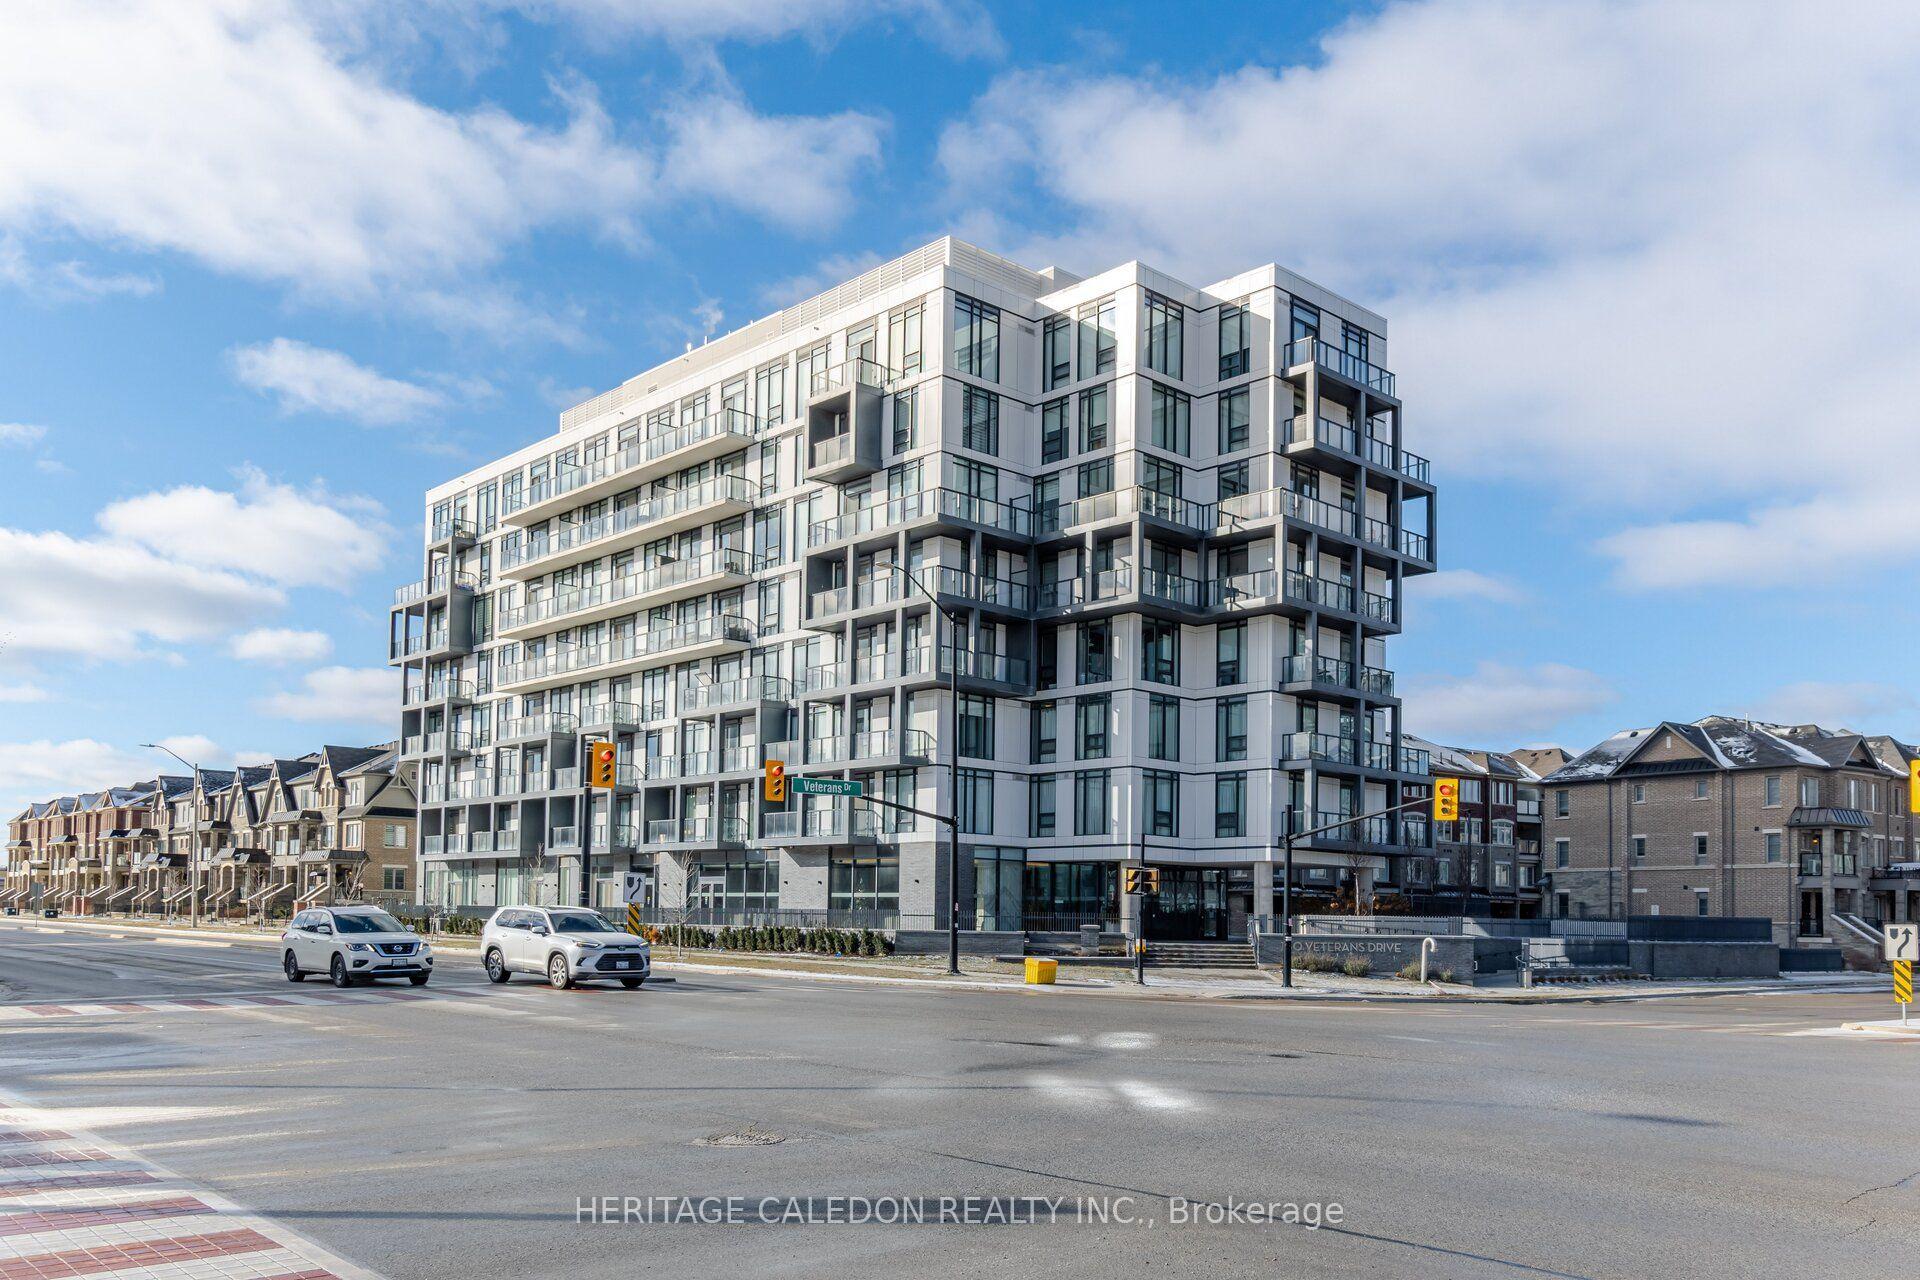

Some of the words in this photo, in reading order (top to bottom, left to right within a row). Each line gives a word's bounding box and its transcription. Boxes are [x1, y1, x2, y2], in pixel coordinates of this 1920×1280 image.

[803, 780, 843, 794] Veterans
[843, 783, 852, 792] Dr
[1305, 941, 1365, 952] VETERANS
[1367, 942, 1402, 953] DRIVE
